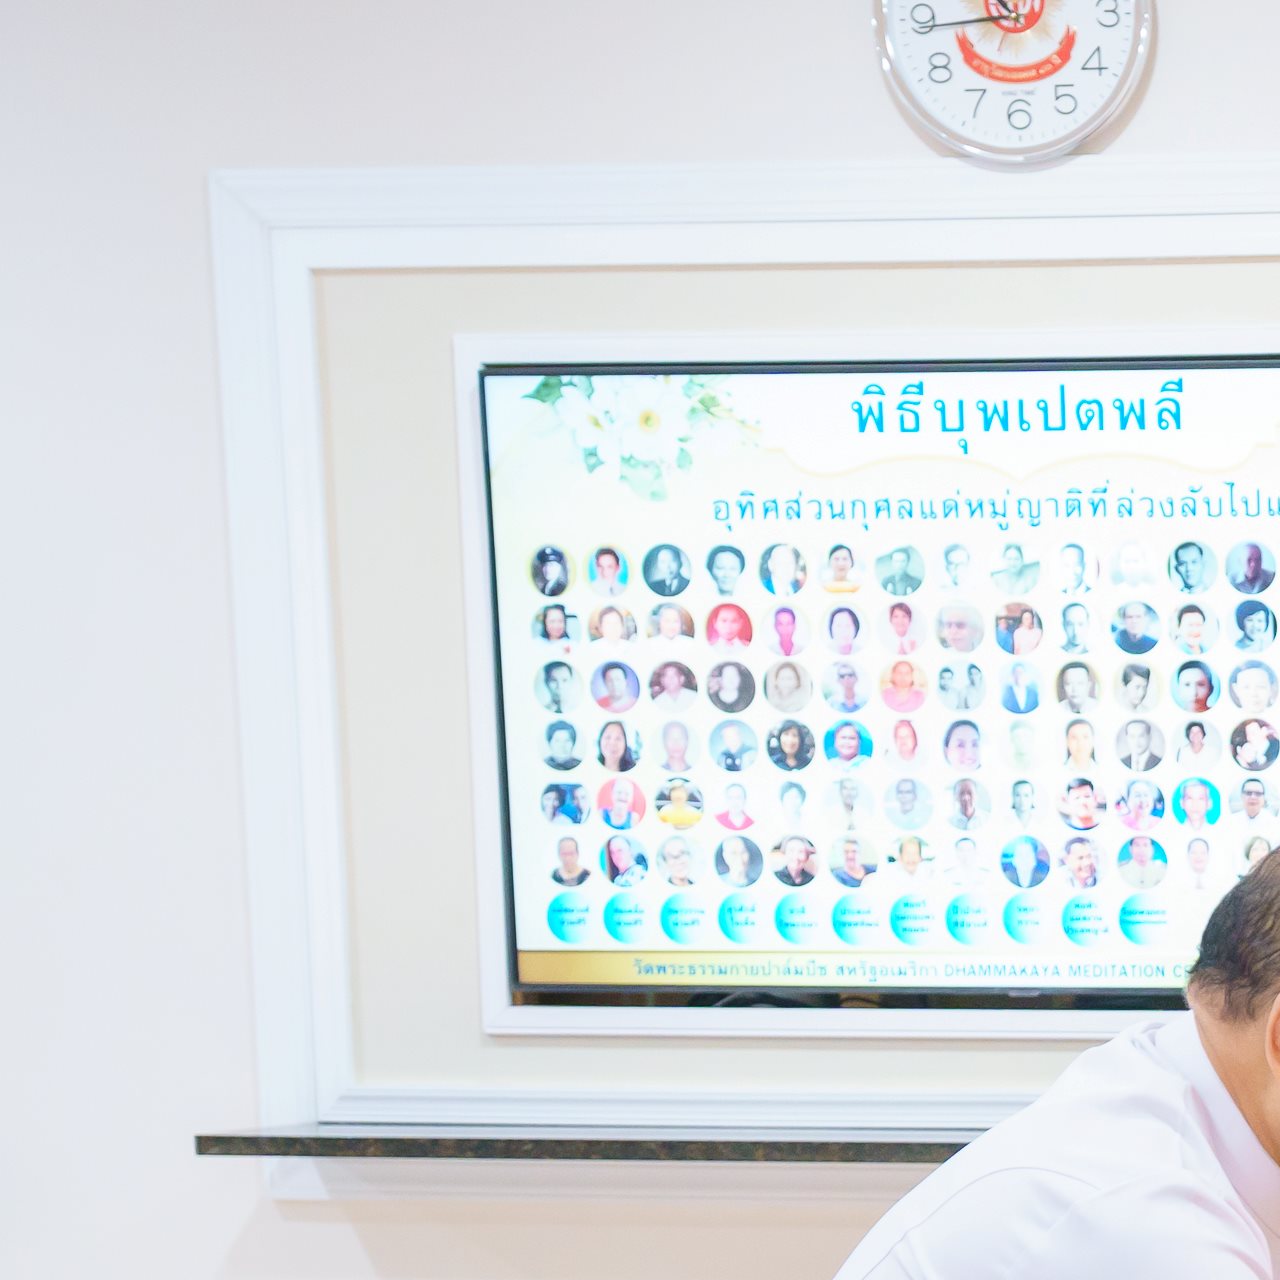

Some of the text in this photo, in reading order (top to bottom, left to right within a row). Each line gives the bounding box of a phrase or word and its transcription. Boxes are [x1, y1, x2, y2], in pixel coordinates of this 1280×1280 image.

[910, 3, 935, 34] 9
[1095, 0, 1120, 28] 3
[928, 52, 953, 84] 8
[1080, 45, 1109, 76] 4
[963, 88, 987, 119] 7
[1007, 98, 1032, 130] 6
[1053, 84, 1078, 115] 5
[850, 377, 1184, 455] พิธีบุพเปตพลี
[944, 963, 1060, 978] DHAMMAKAYA
[1068, 963, 1166, 978] MEDITATION
